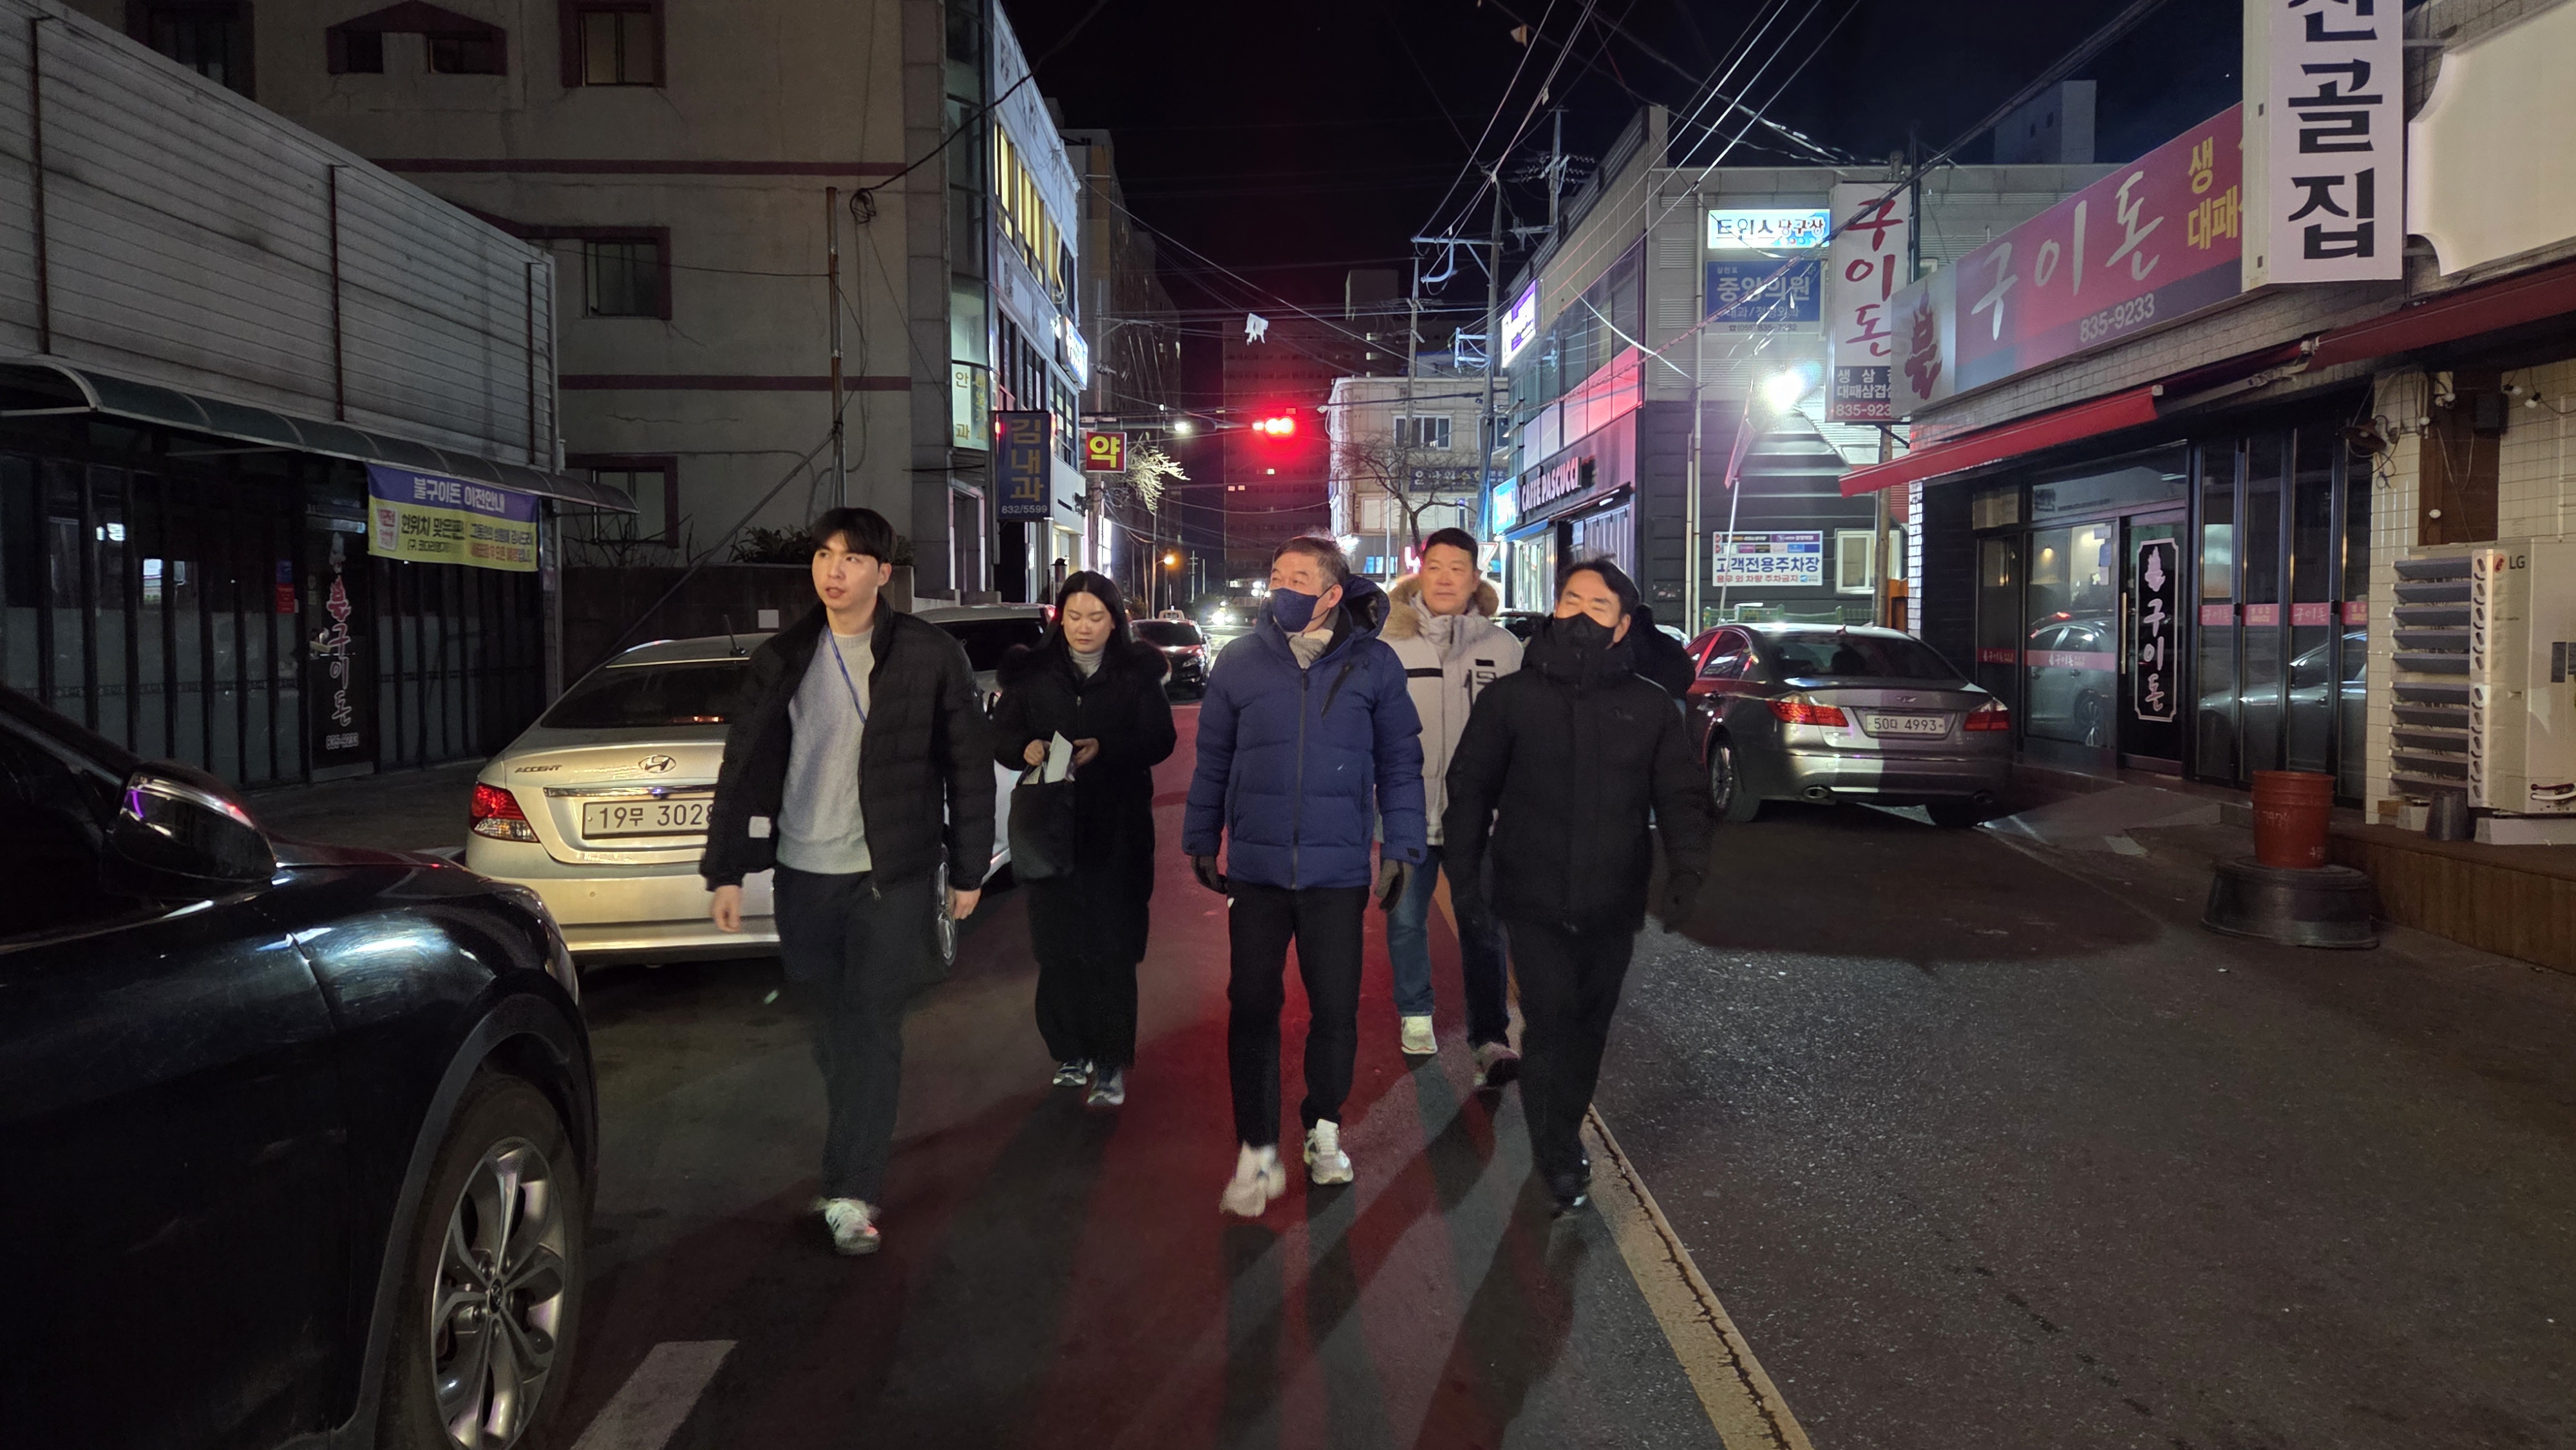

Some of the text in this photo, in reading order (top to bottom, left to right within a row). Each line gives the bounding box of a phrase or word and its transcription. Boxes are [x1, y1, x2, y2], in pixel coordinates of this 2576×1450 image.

[2188, 184, 2242, 250] 대패
[1717, 276, 1810, 302] 중앙의원
[1844, 197, 1903, 357] 구이돈
[2079, 294, 2155, 343] 835-9233
[1010, 419, 1043, 502] 김내과
[1089, 435, 1121, 469] 약
[1541, 457, 1578, 504] PASCUCCI
[413, 476, 506, 513] 불구이돈 이전안내
[1001, 504, 1048, 514] 832/5599
[401, 514, 430, 536] 현위치
[1716, 556, 1820, 573] 고객전용주차장
[2509, 554, 2525, 569] LG
[1765, 574, 1799, 583] 주차금지
[1904, 719, 1937, 731] 4993
[514, 765, 563, 773] ACCENT
[599, 807, 643, 829] 19무
